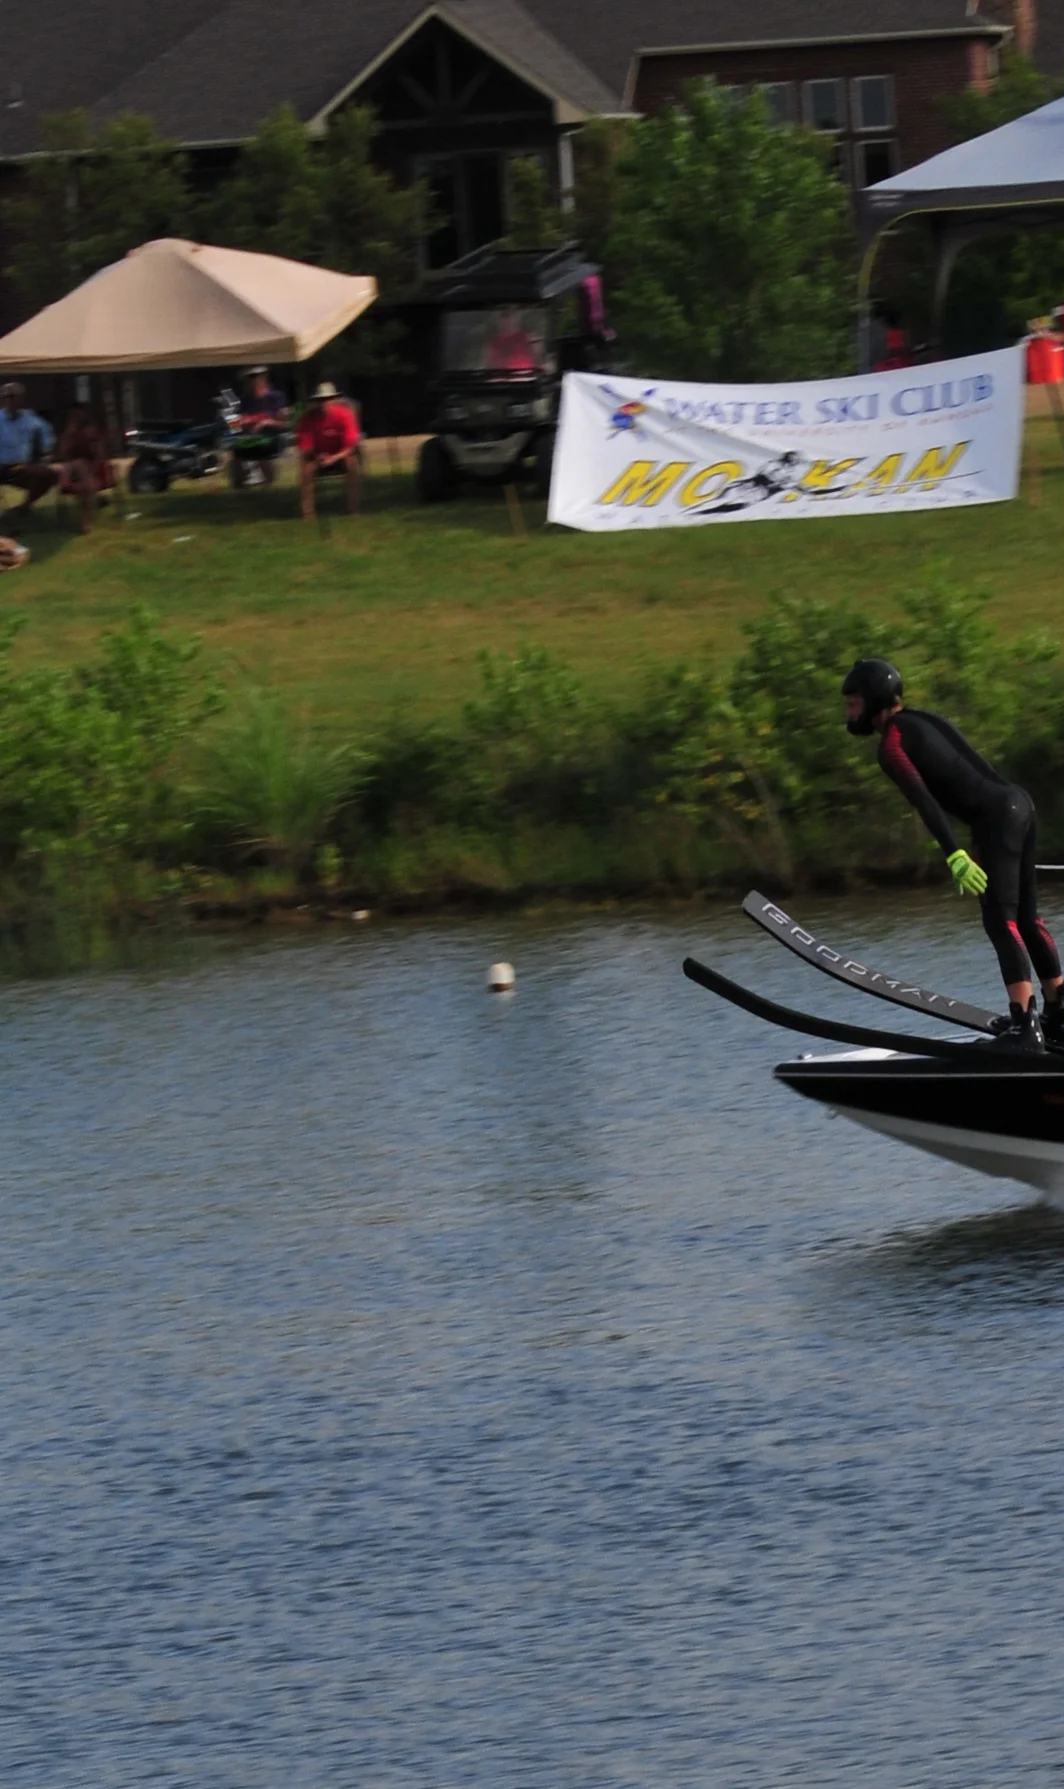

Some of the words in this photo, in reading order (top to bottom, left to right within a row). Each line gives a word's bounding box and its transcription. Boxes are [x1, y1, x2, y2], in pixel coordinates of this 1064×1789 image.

[662, 399, 802, 425] WATER
[815, 393, 881, 424] SKI
[890, 373, 994, 417] CLUB
[761, 903, 957, 1008] GOODMAN
